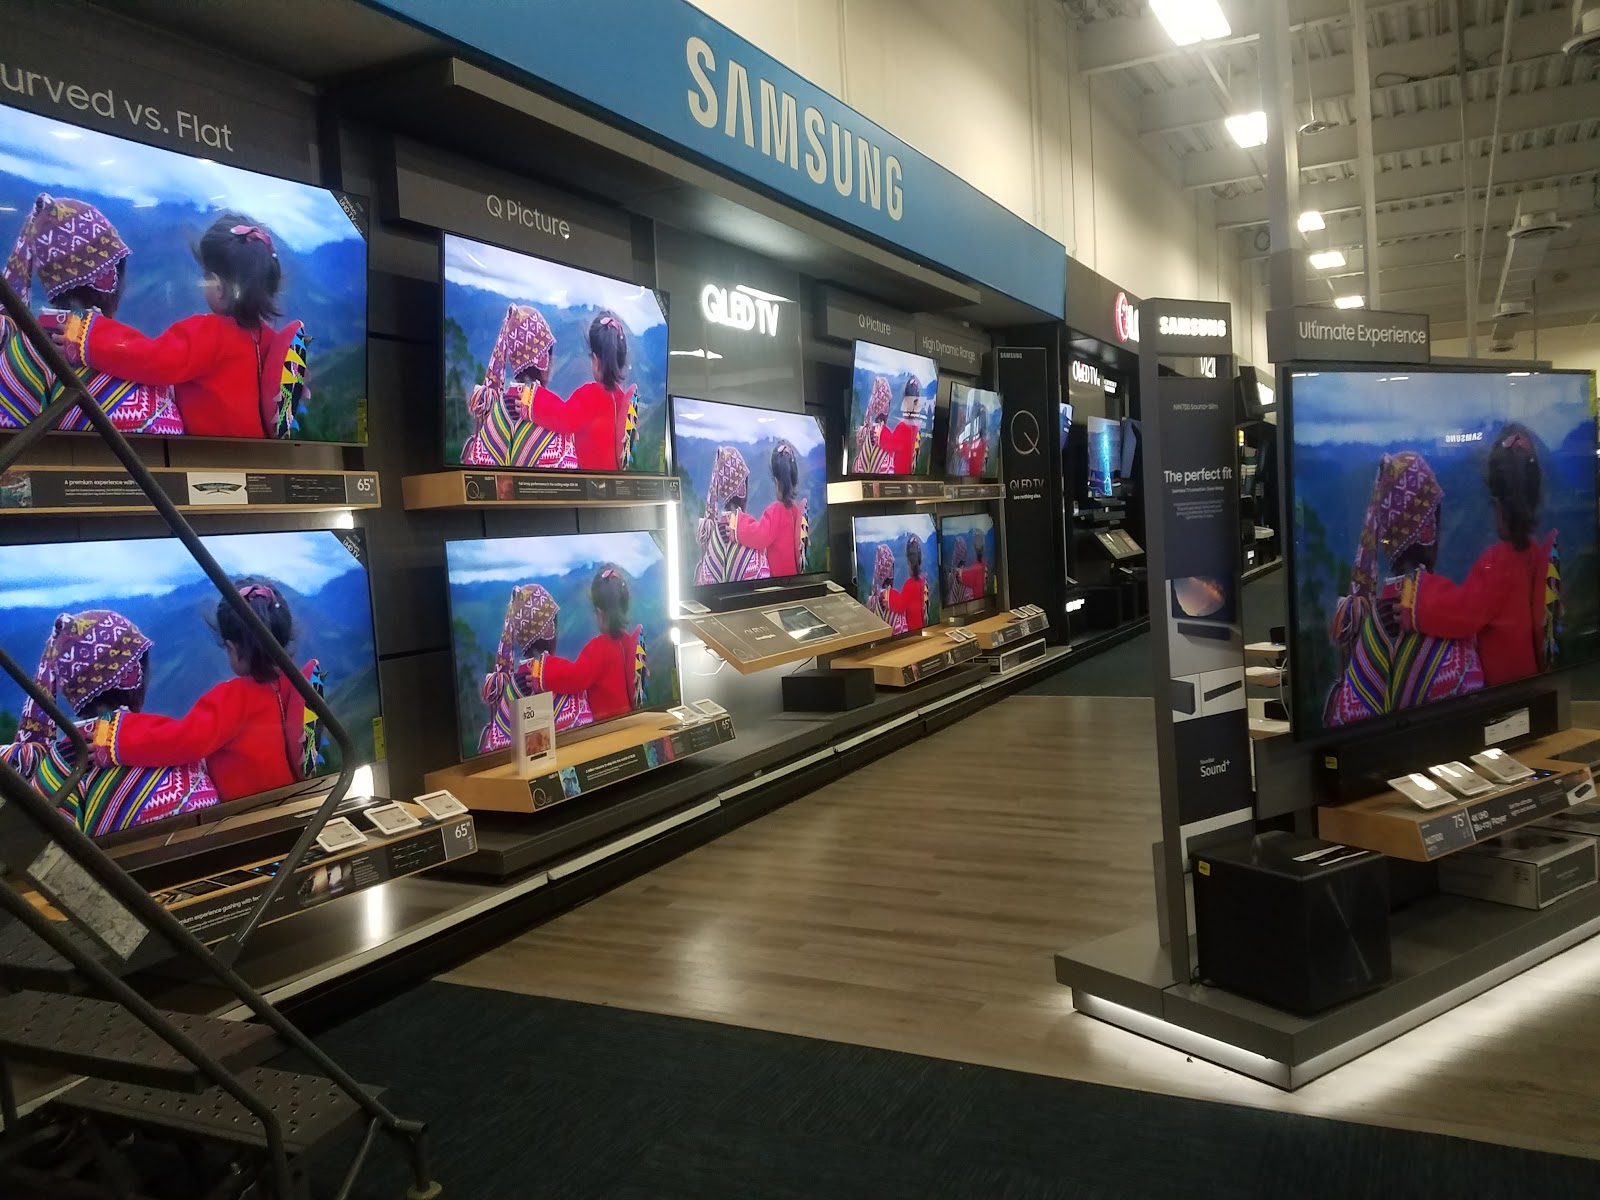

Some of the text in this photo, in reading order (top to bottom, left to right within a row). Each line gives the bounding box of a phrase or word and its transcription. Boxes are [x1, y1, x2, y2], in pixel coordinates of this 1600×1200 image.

[0, 63, 234, 152] urved vs. Flat
[686, 36, 903, 221] SAMSUNG
[486, 194, 570, 239] Q Picture
[702, 283, 779, 337] QLED TV
[858, 313, 891, 336] Q Picture
[1159, 315, 1227, 337] SAMSUNG
[1300, 320, 1426, 347] Ultimate Experience
[922, 336, 976, 364] High Dynamic Range
[1164, 466, 1233, 486] The perfect fit
[1492, 814, 1508, 827] Player
